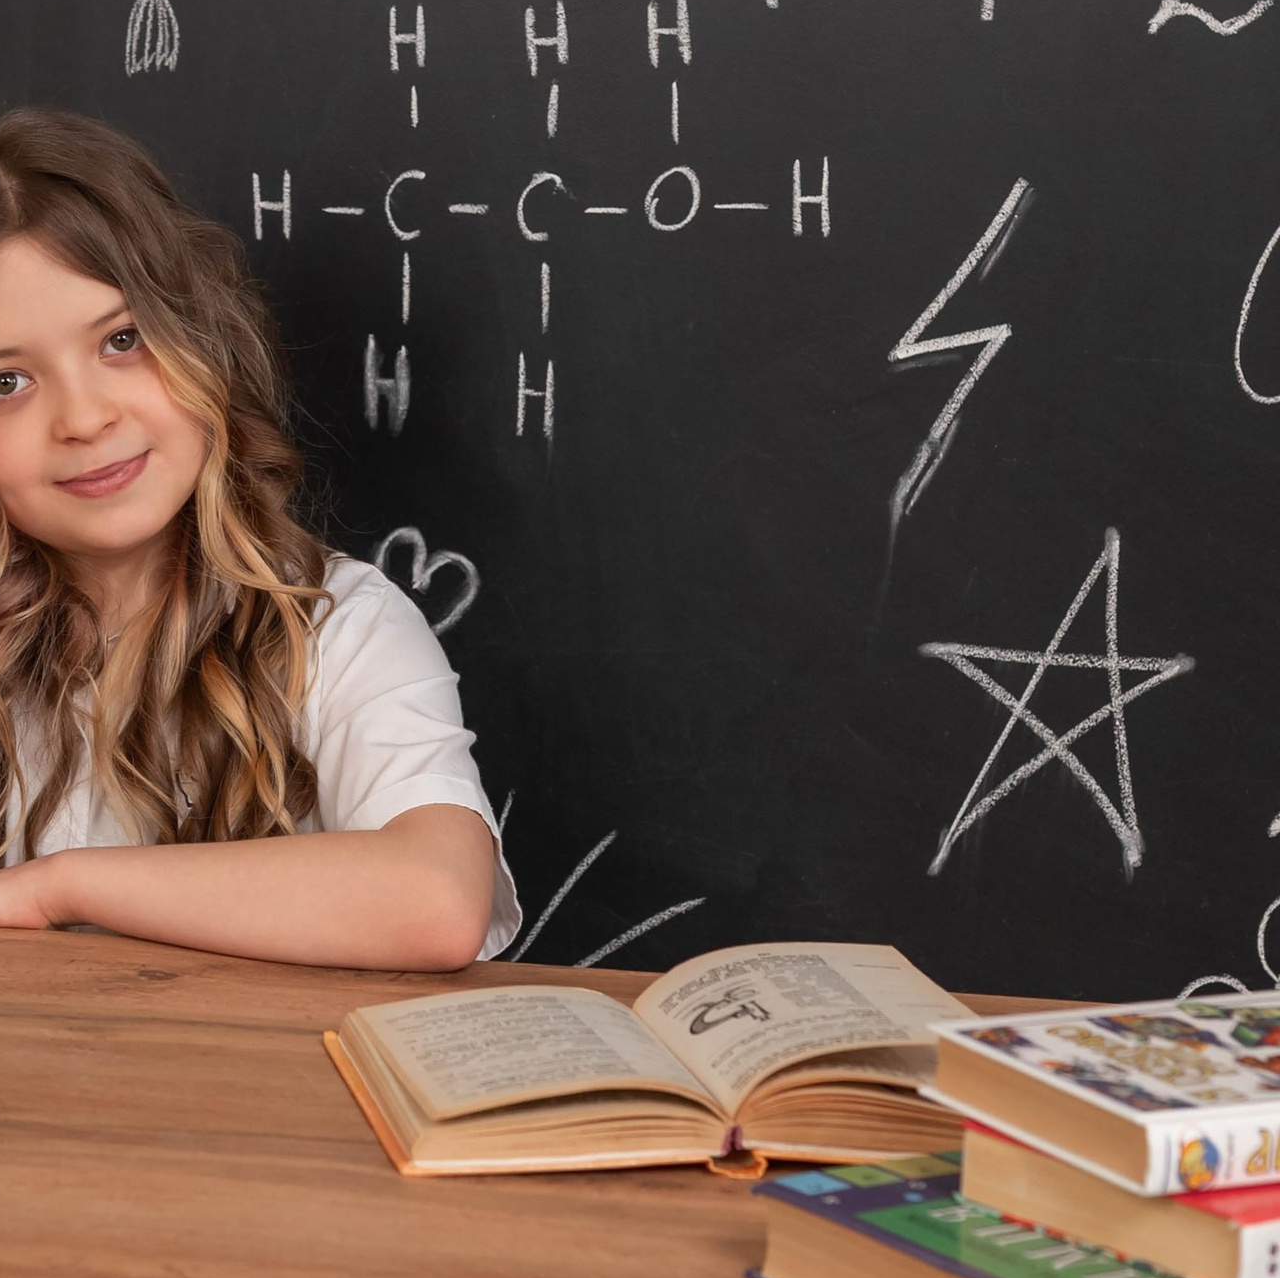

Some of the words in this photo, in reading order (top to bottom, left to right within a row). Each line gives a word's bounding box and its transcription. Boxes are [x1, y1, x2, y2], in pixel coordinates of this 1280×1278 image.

[389, 5, 425, 70] H
[525, 1, 568, 76] H
[365, 334, 410, 426] H
[517, 352, 554, 440] H
